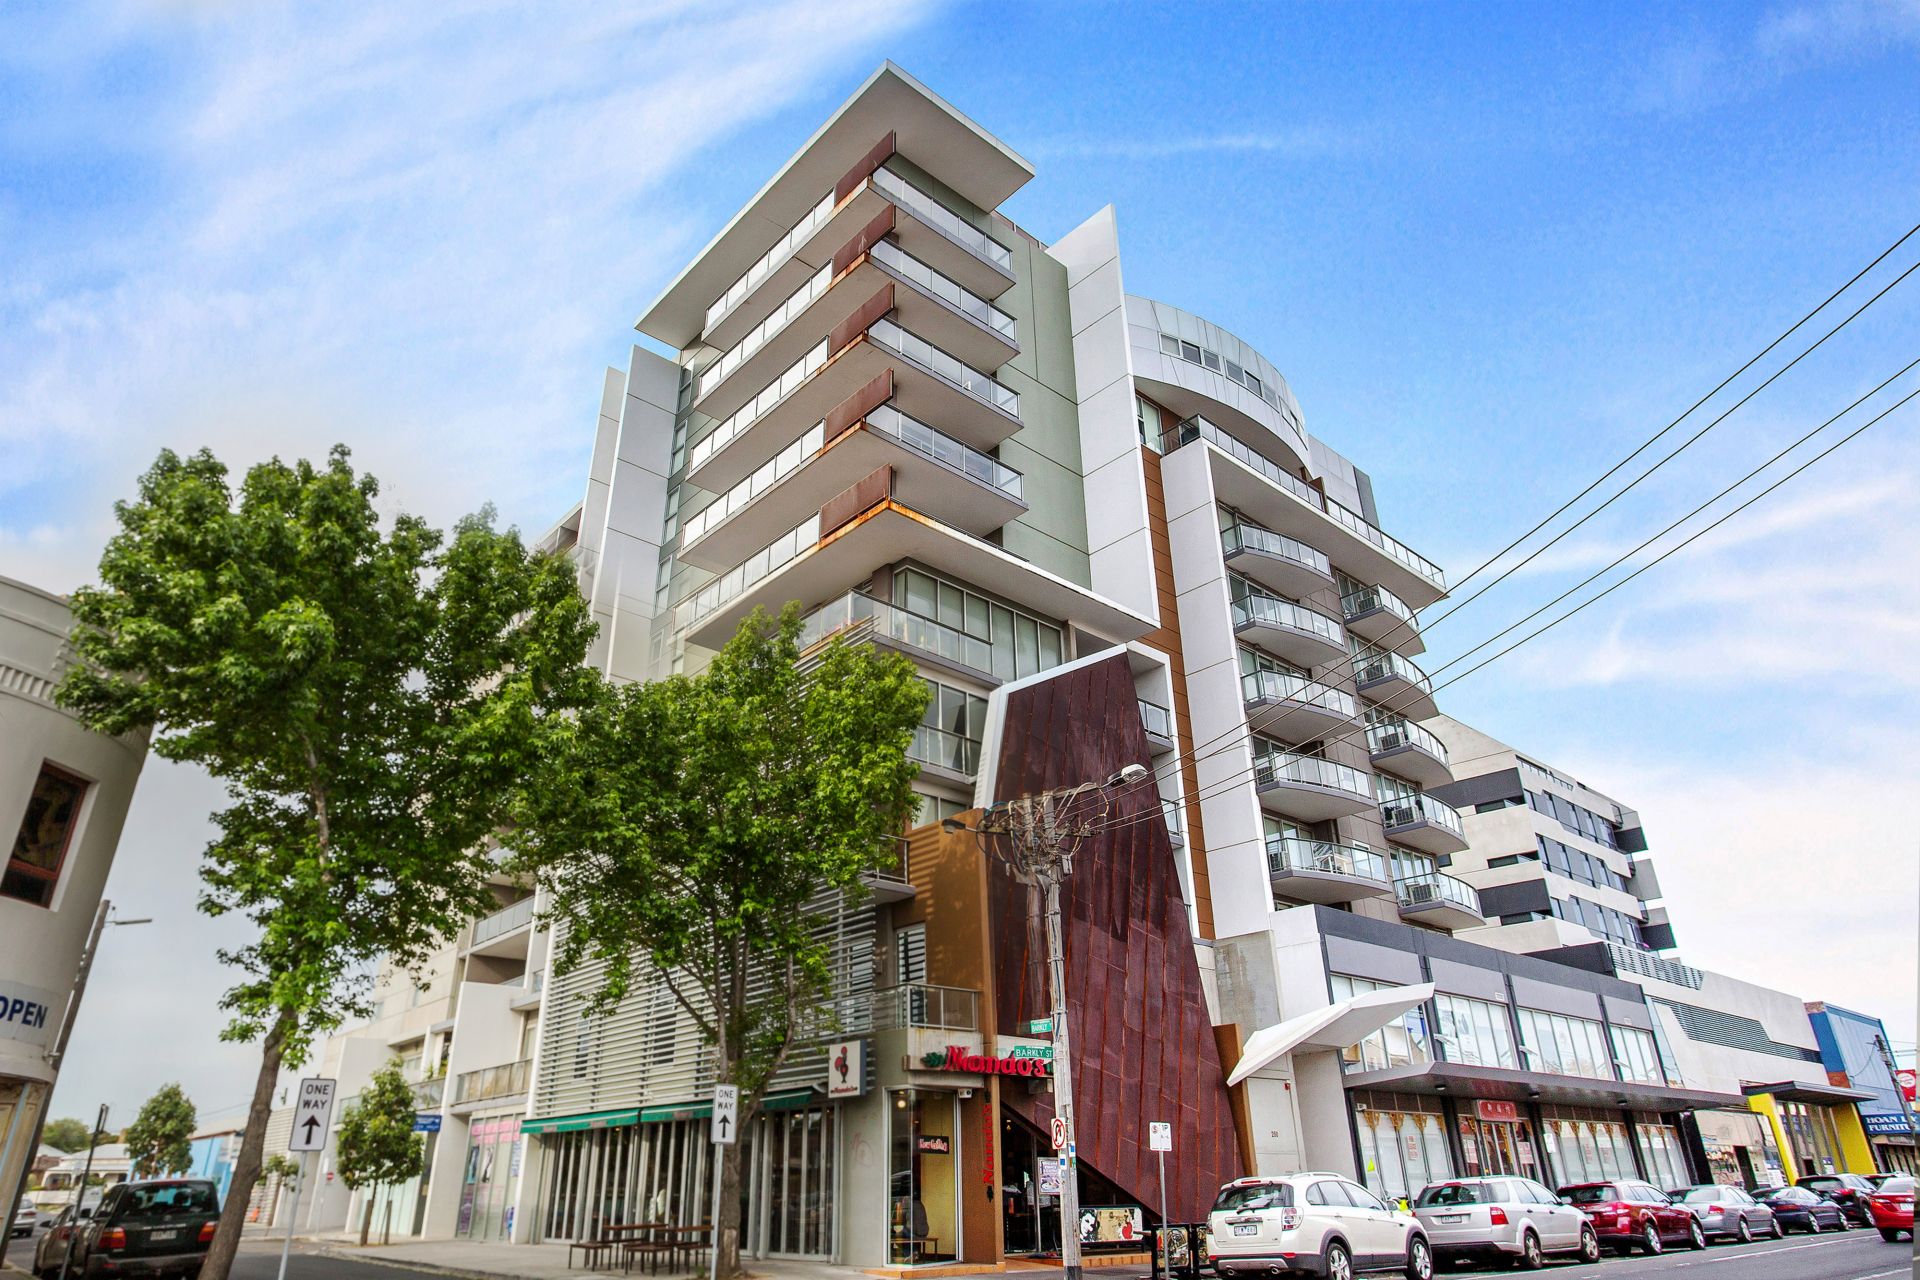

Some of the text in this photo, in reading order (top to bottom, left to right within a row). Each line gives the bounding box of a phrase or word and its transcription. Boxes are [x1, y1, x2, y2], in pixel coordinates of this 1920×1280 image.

[1015, 1049, 1053, 1058] BARKLY ST
[305, 1084, 330, 1095] ONE
[719, 1090, 734, 1098] ONE
[303, 1099, 327, 1110] WAY
[717, 1102, 733, 1110] WAY
